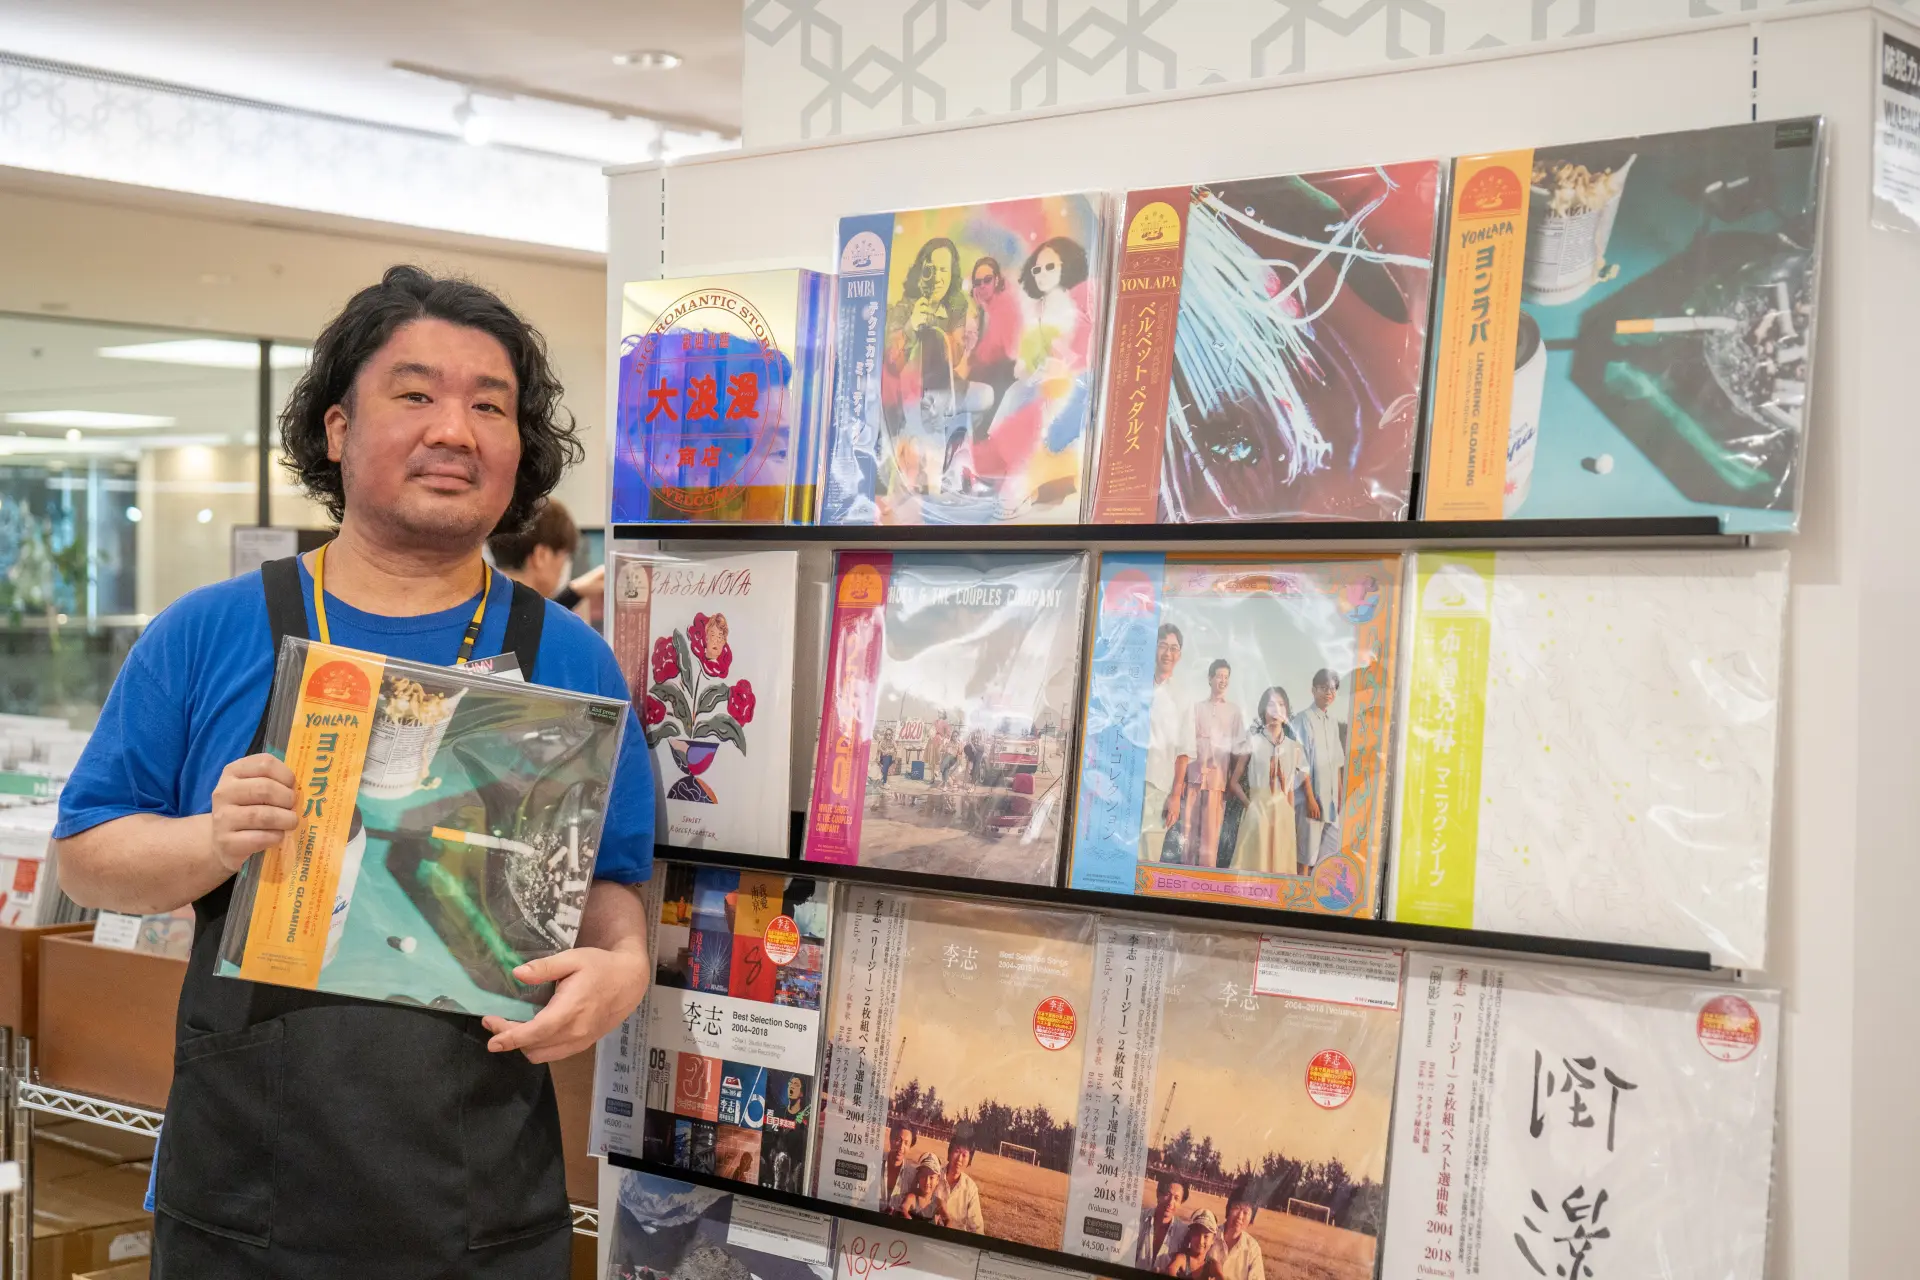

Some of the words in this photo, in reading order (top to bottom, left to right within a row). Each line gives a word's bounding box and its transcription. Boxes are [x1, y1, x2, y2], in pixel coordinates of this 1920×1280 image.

[1461, 221, 1514, 249] YONLAPA
[1121, 275, 1177, 292] YONLAPA
[1467, 245, 1496, 347] ヨンラパ
[636, 340, 656, 374] BIG
[655, 294, 737, 335] ROMANTIC
[739, 306, 775, 364] STORE
[1136, 301, 1157, 382] ベルベット
[1473, 352, 1485, 417] LINGERING
[645, 372, 760, 423] 大浪漫
[1123, 385, 1147, 455] ペタルス
[677, 445, 722, 468] 商店
[1466, 422, 1479, 487] GLOAMING
[661, 479, 739, 507] WELCOME
[956, 587, 1002, 606] COUPLES
[1005, 588, 1063, 608] COMPANY
[465, 658, 495, 672] HMV
[305, 712, 360, 729] YONLAPA
[301, 732, 340, 819] ヨンラパ
[681, 815, 702, 824] SUNSET
[815, 822, 840, 833] COMPANY
[831, 814, 852, 825] COUPLES
[299, 824, 319, 883] LINGERING
[1157, 876, 1188, 891] BEST
[1191, 880, 1273, 899] COLLECTION
[286, 886, 305, 943] GLOAMING
[942, 943, 979, 971] 李志
[1048, 999, 1065, 1013] 李志
[1217, 980, 1260, 1011] 李志
[682, 1001, 724, 1036] 李志
[732, 1011, 749, 1021] Best
[750, 1013, 783, 1027] Selection
[784, 1019, 808, 1033] Songs
[731, 1023, 769, 1037] 2004~2018
[649, 1047, 667, 1071] 08
[1321, 1052, 1341, 1067] 李志
[612, 1082, 629, 1094] 2018
[845, 1109, 866, 1124] 2004
[843, 1131, 863, 1146] 2018
[1096, 1162, 1119, 1178] 2004
[833, 1179, 854, 1192] ¥4,500
[1093, 1186, 1117, 1202] 2018
[1426, 1219, 1453, 1236] 2004
[1081, 1239, 1105, 1252] ¥4,500
[1110, 1245, 1121, 1255] TAX
[1424, 1246, 1452, 1263] 2018
